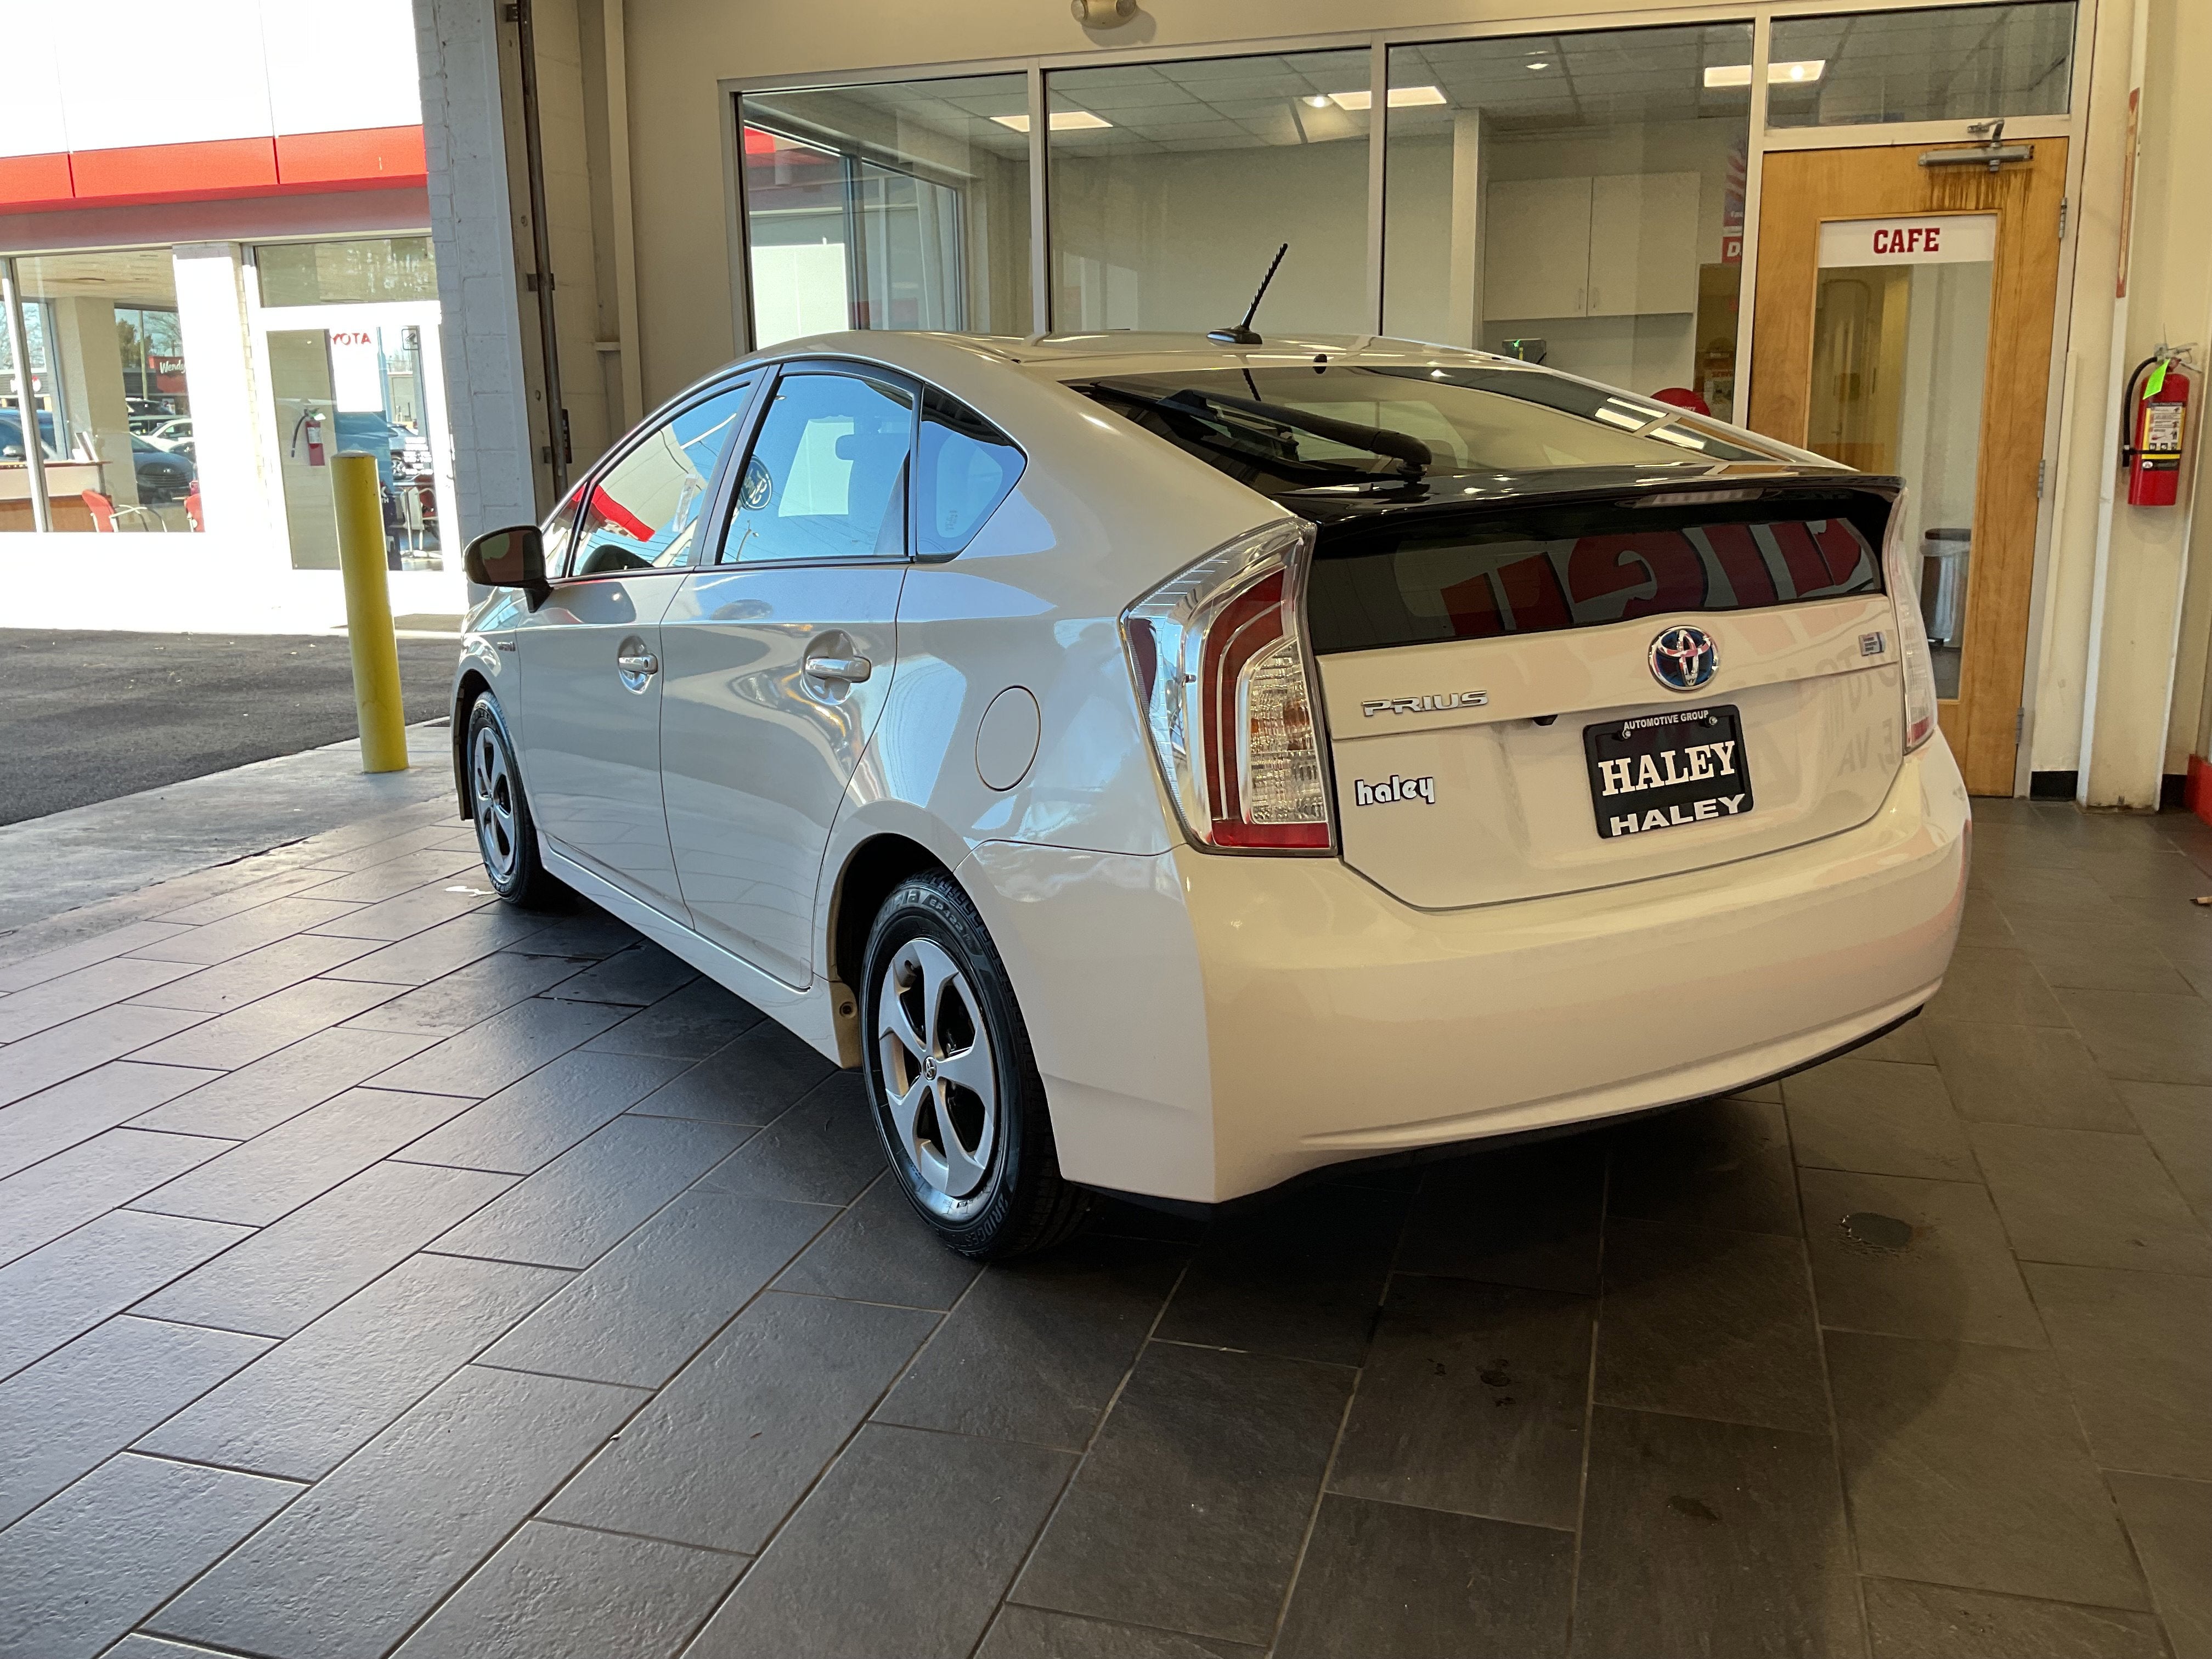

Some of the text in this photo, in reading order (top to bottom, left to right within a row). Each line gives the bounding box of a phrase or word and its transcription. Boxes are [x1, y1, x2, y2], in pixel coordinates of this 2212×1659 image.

[1873, 228, 1940, 254] CAFE
[1361, 690, 1489, 716] PRIUS
[1623, 710, 1709, 730] AUTOMOTIVE GROUP
[1598, 740, 1735, 796] HALEY
[1355, 775, 1435, 806] haley
[1610, 793, 1745, 836] HALEY
